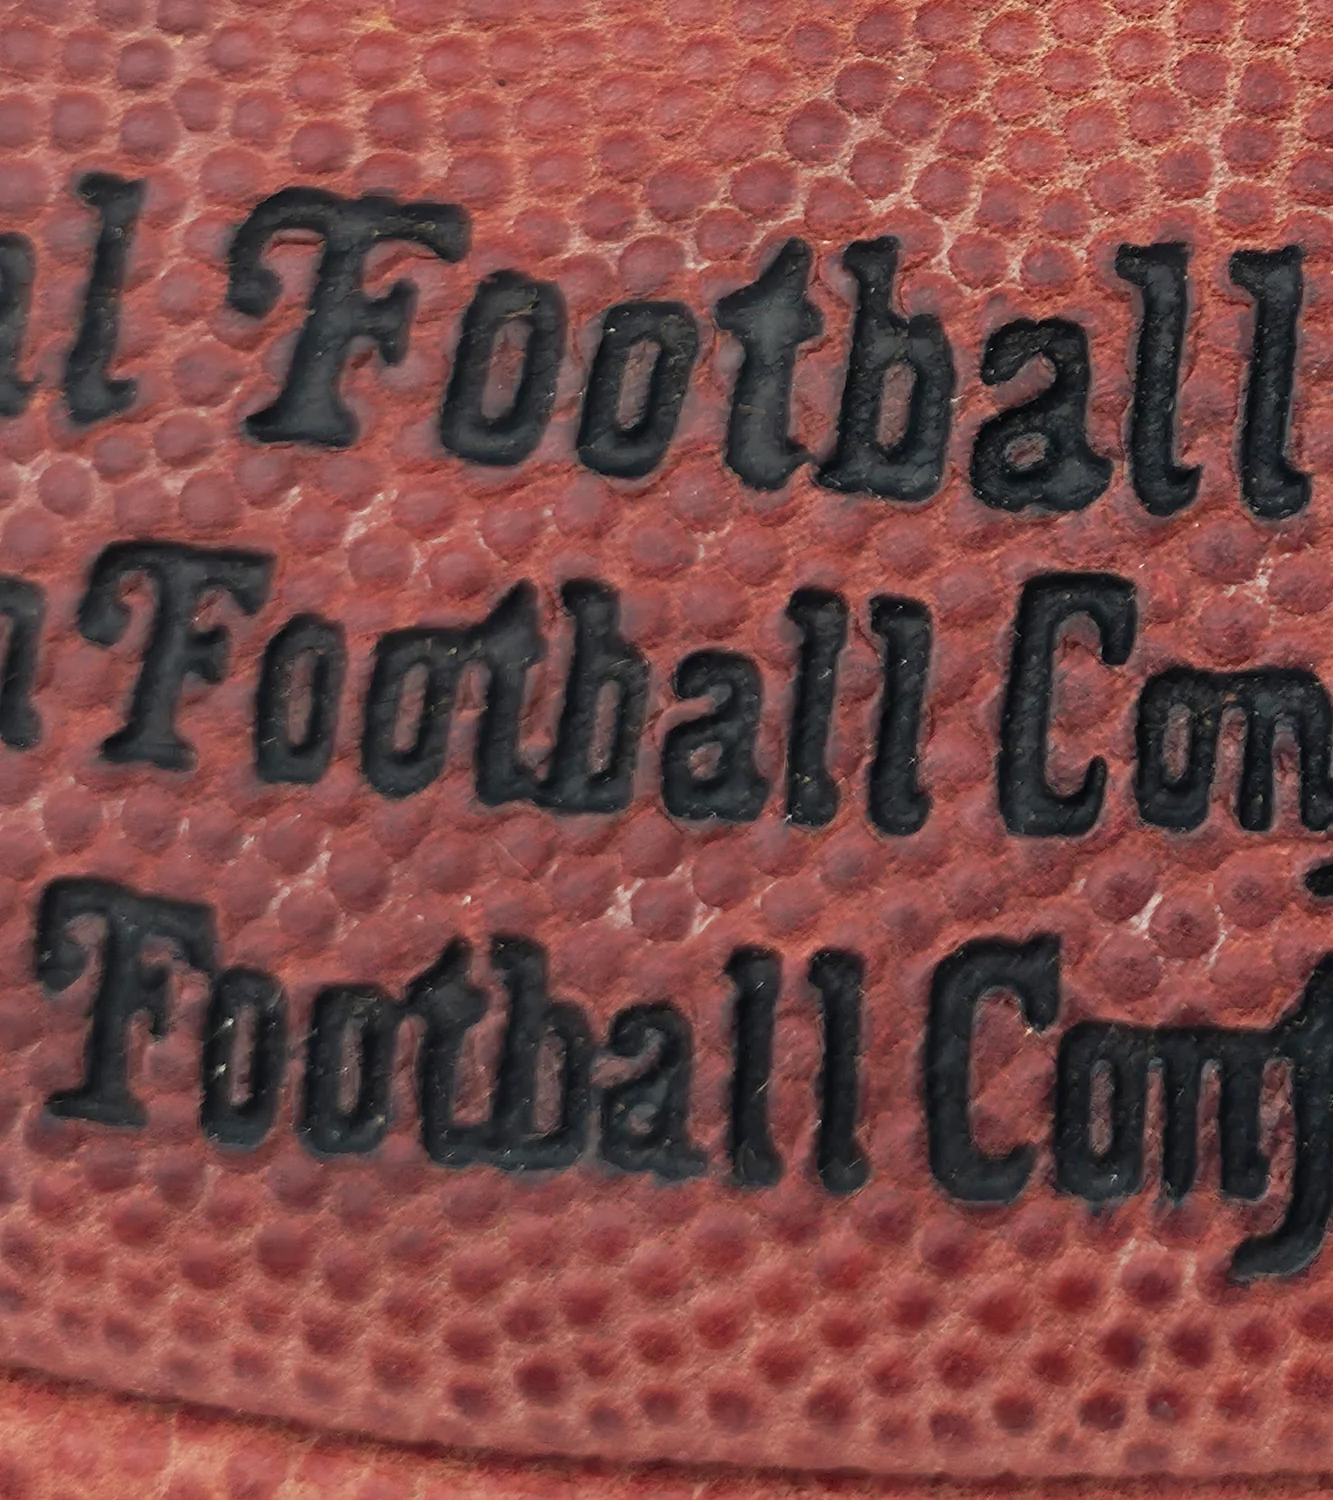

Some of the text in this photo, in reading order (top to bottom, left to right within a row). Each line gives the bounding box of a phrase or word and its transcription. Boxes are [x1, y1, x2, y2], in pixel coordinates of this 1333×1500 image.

[225, 184, 1314, 520] Football
[77, 538, 935, 838] Football
[34, 875, 871, 1197] Football
